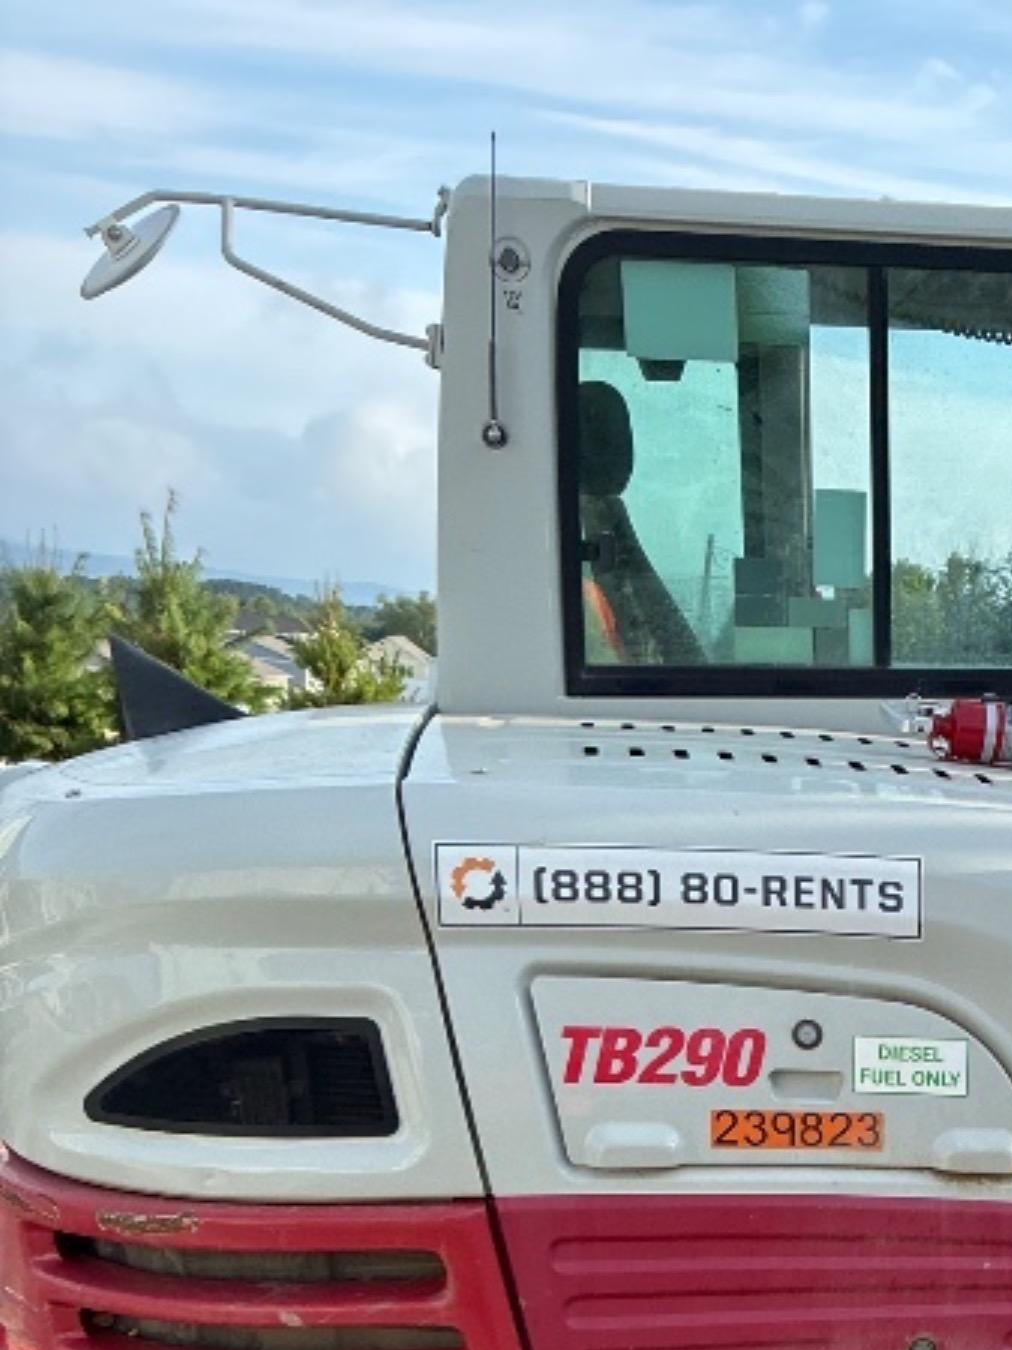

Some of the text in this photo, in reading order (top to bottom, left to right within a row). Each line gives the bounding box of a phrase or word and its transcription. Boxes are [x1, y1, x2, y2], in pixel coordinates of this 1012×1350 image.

[533, 867, 904, 913] (888) 80-RENTS
[560, 1025, 766, 1087] TB290
[878, 1043, 944, 1063] DIESEL
[860, 1067, 961, 1087] FUEL ONLY
[713, 1109, 882, 1148] 239823
